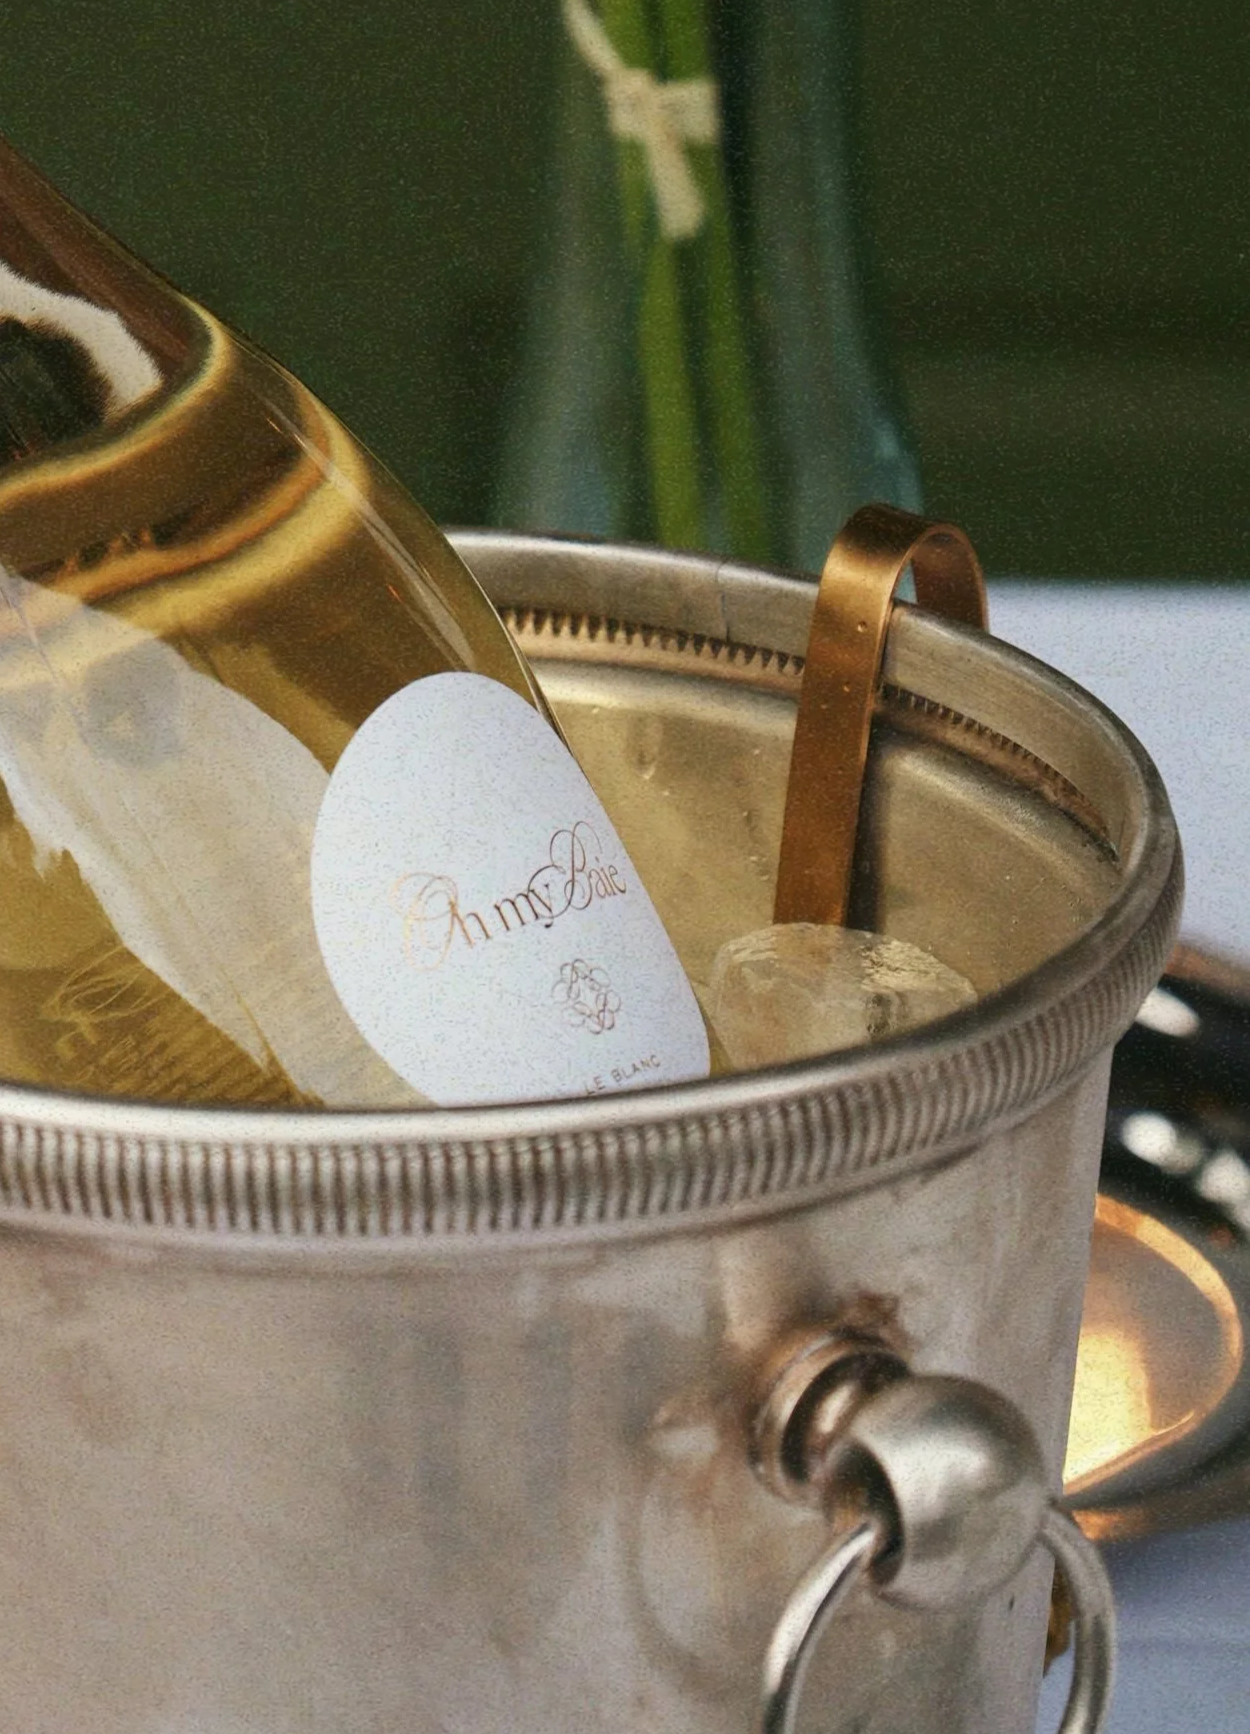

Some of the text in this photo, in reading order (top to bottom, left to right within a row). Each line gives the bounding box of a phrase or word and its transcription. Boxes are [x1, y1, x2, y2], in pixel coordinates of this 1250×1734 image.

[494, 883, 554, 929] my
[528, 820, 627, 919] Baie
[584, 1054, 662, 1096] LE BLANC
